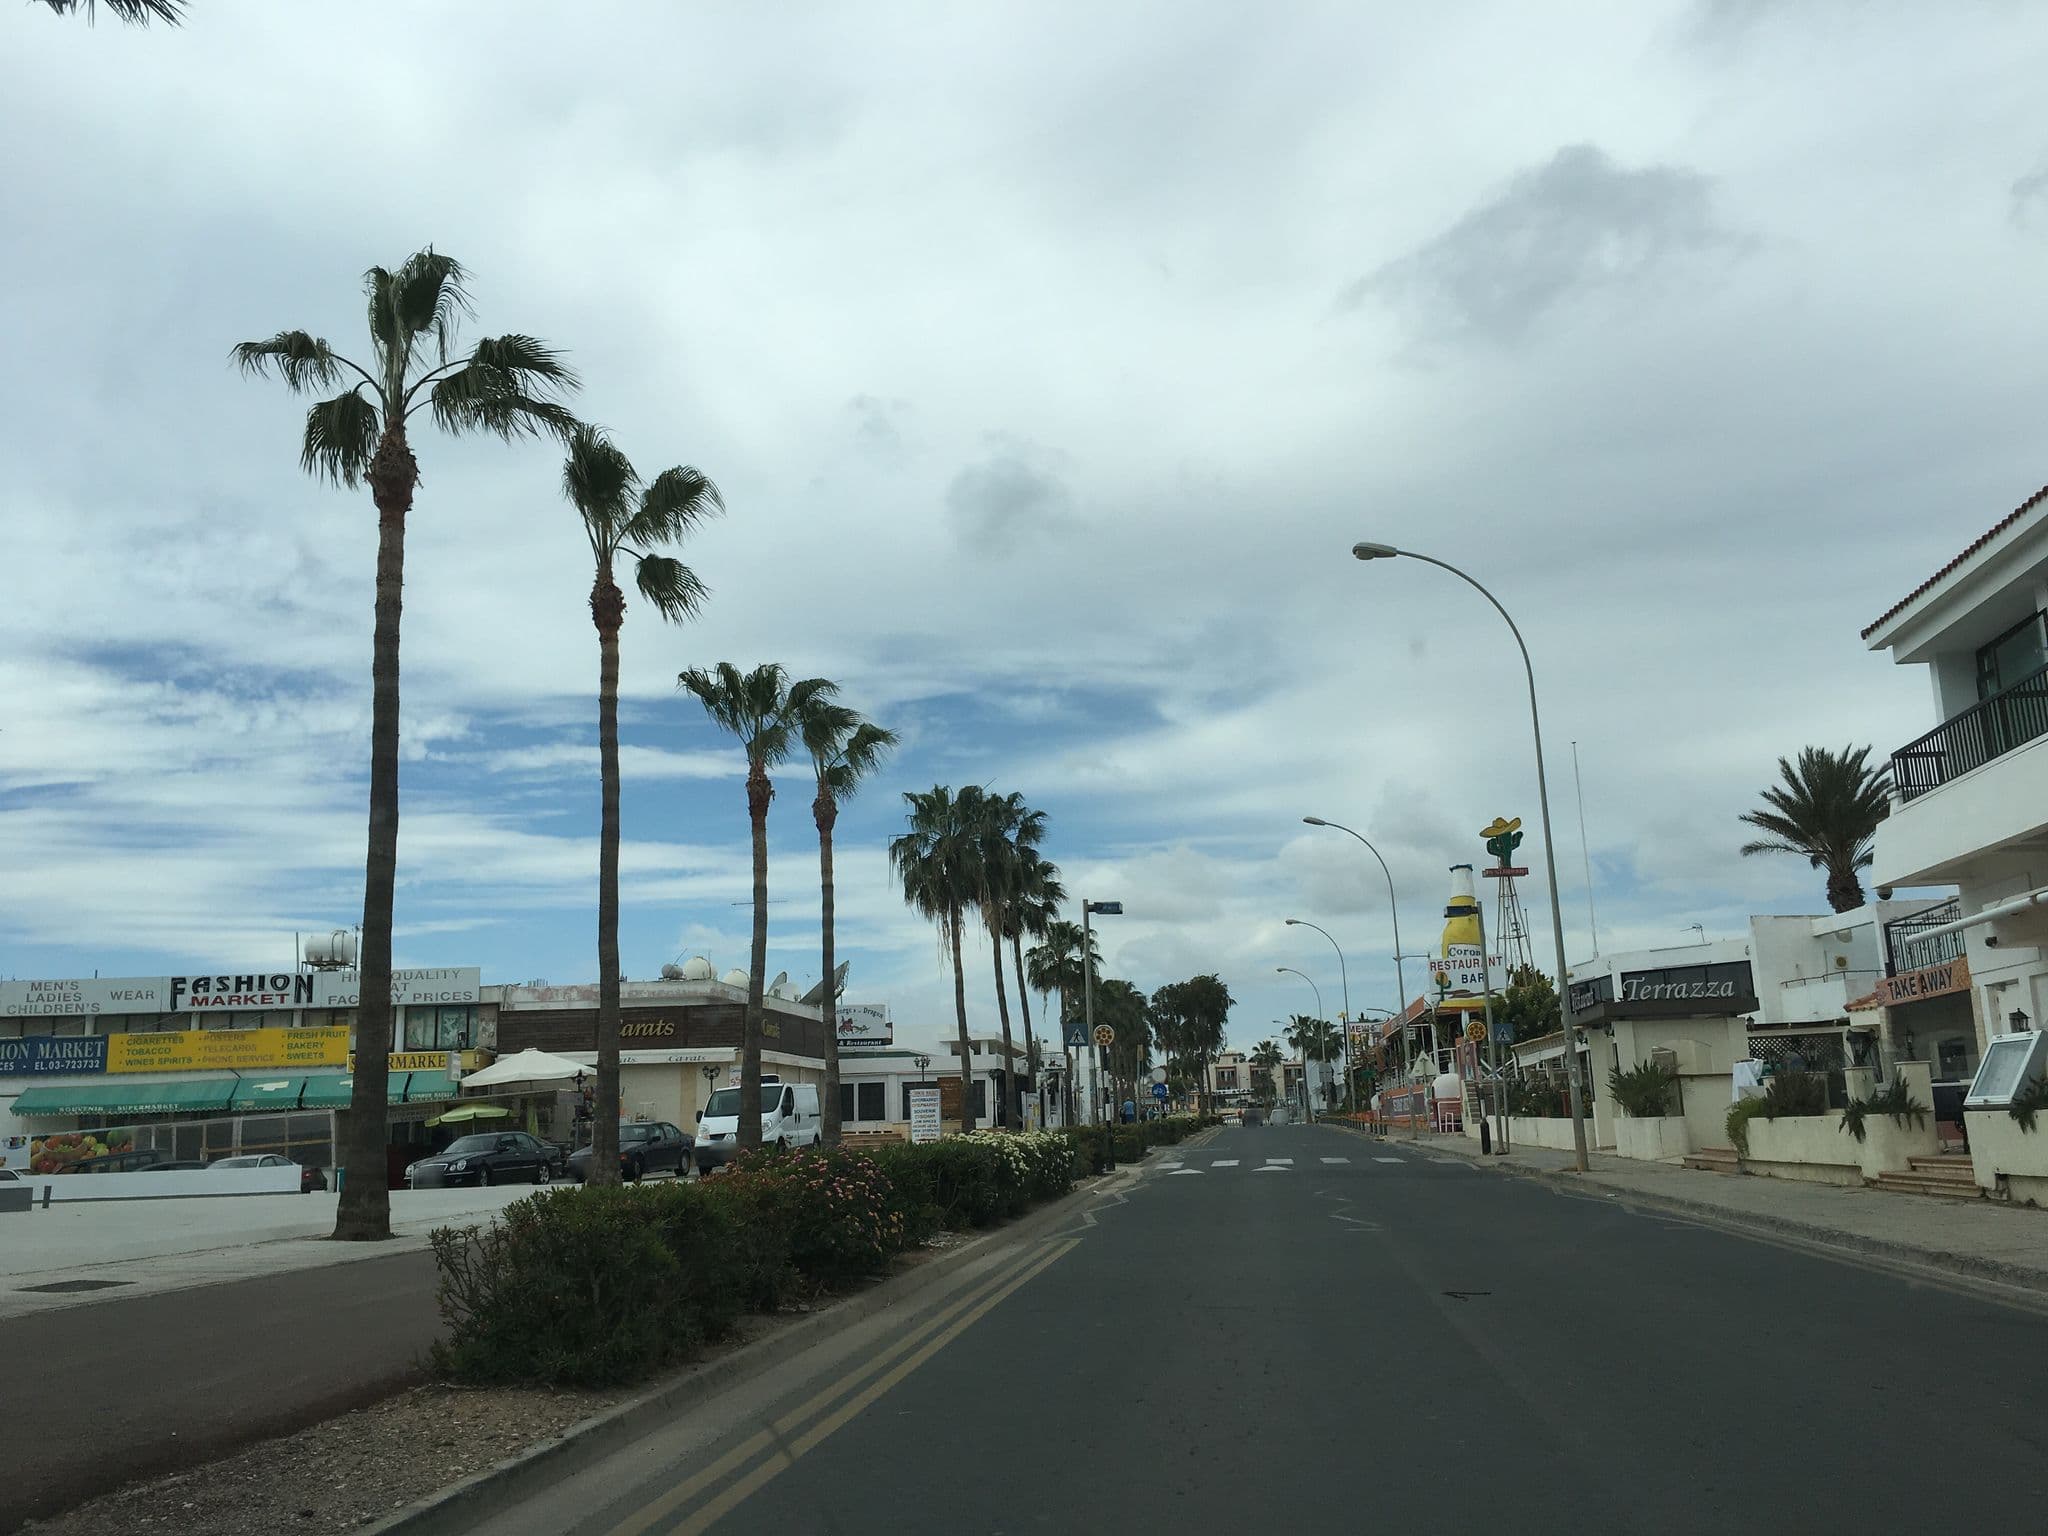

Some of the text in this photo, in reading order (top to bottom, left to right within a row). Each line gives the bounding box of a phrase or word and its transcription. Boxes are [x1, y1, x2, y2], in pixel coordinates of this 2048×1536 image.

[1449, 946, 1481, 957] Coron
[1429, 956, 1503, 972] RESTAURNT
[391, 969, 460, 981] QUALITY
[30, 981, 79, 992] MEN'S
[1623, 977, 1736, 1001] Terrazza
[1887, 966, 1953, 1001] TAKE AWAY
[26, 992, 82, 1003] LADIES
[110, 990, 155, 1001] WEAR
[170, 974, 314, 1012] FASHION
[413, 991, 473, 1002] PRICES
[191, 993, 290, 1006] MARKET
[7, 1003, 100, 1014] CHILDREN'S
[619, 1019, 675, 1037] arats
[287, 1030, 347, 1040] FRESH FRUIT
[127, 1036, 184, 1046] CIGARETTES
[287, 1041, 325, 1050] BAKERY
[37, 1041, 104, 1059] MARKET
[127, 1047, 171, 1056] TOBACCO
[125, 1056, 193, 1067] WINES SPIRITS
[287, 1052, 325, 1060] SWEETS
[117, 1103, 179, 1112] SUPERMARKET
